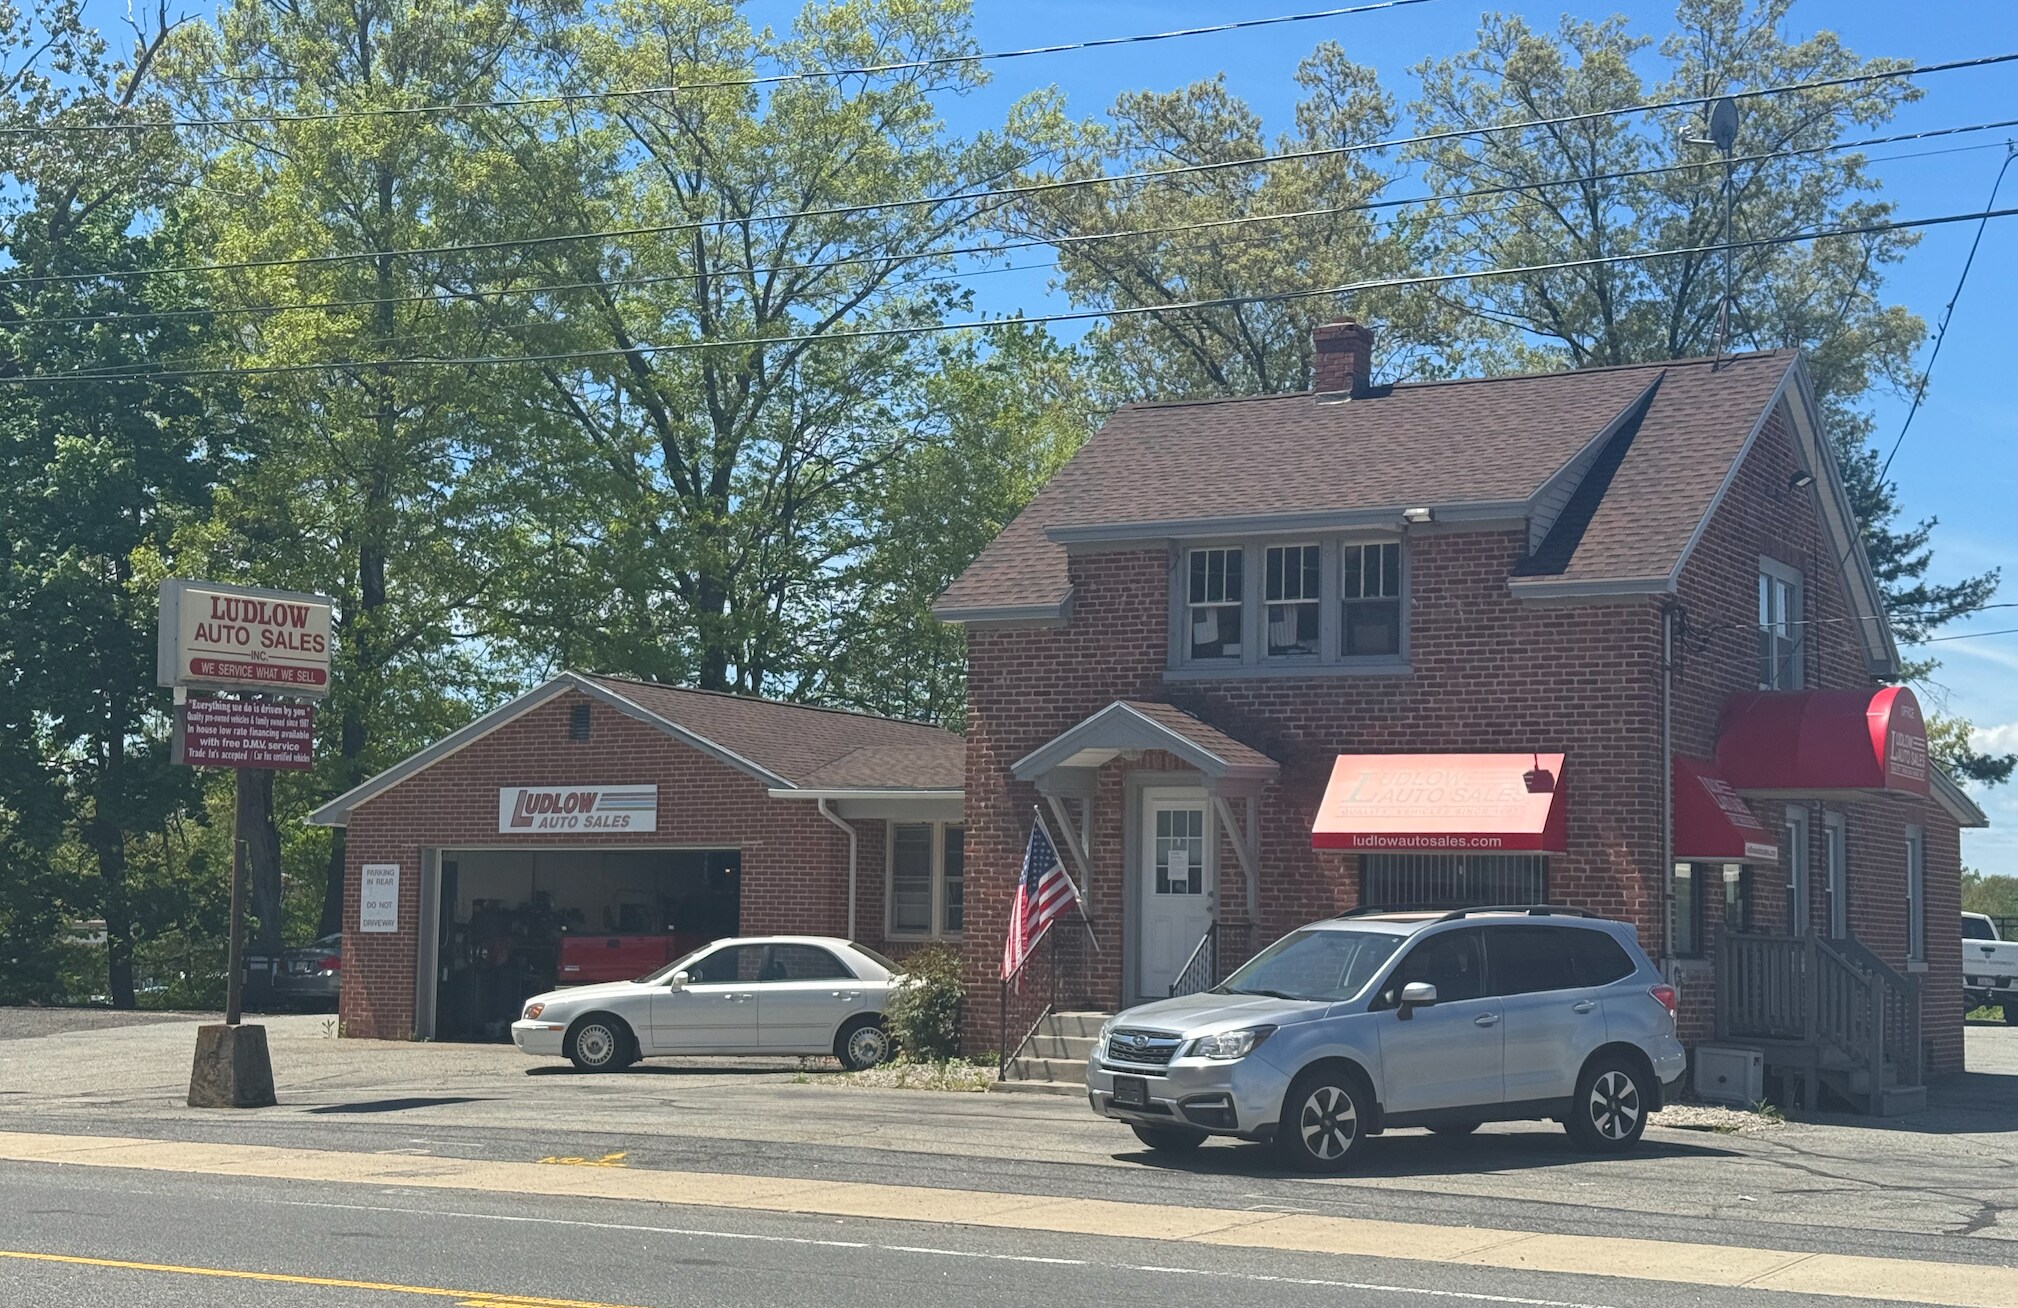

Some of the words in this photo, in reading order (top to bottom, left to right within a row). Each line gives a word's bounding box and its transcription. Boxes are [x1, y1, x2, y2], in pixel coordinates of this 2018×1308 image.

[211, 596, 310, 628] LUDLOW
[195, 623, 250, 645] AUTO
[261, 629, 325, 653] SALES
[251, 651, 268, 661] INC.
[201, 662, 214, 674] WE
[219, 665, 252, 678] SERVICE
[257, 667, 278, 679] WHAT
[282, 669, 293, 680] WE
[297, 670, 315, 682] SELL
[244, 703, 252, 712] do
[254, 704, 259, 712] is
[261, 704, 282, 715] driven
[284, 705, 292, 717] by
[187, 711, 204, 723] Quality
[205, 713, 229, 723] pre-owned
[231, 714, 249, 724] vehicles
[251, 715, 254, 723] &
[256, 716, 269, 727] family
[270, 718, 284, 726] owned
[286, 718, 298, 727] since
[188, 724, 194, 733] In
[196, 725, 216, 734] house
[220, 726, 231, 735] low
[234, 728, 247, 736] rate
[250, 728, 279, 740] financing
[282, 730, 309, 740] available
[200, 738, 219, 747] with
[222, 738, 240, 748] free
[268, 740, 299, 751] service
[188, 748, 206, 758] Trade
[222, 750, 248, 761] accepted
[254, 751, 262, 761] Car
[1376, 788, 1451, 803] AUTO
[1456, 787, 1525, 803] SALES
[510, 790, 598, 827] LUDLOW
[538, 816, 578, 828] AUTO
[584, 815, 631, 828] SALES
[1353, 835, 1501, 847] ludlowautosales.com
[363, 919, 395, 927] DRIVEWAY
